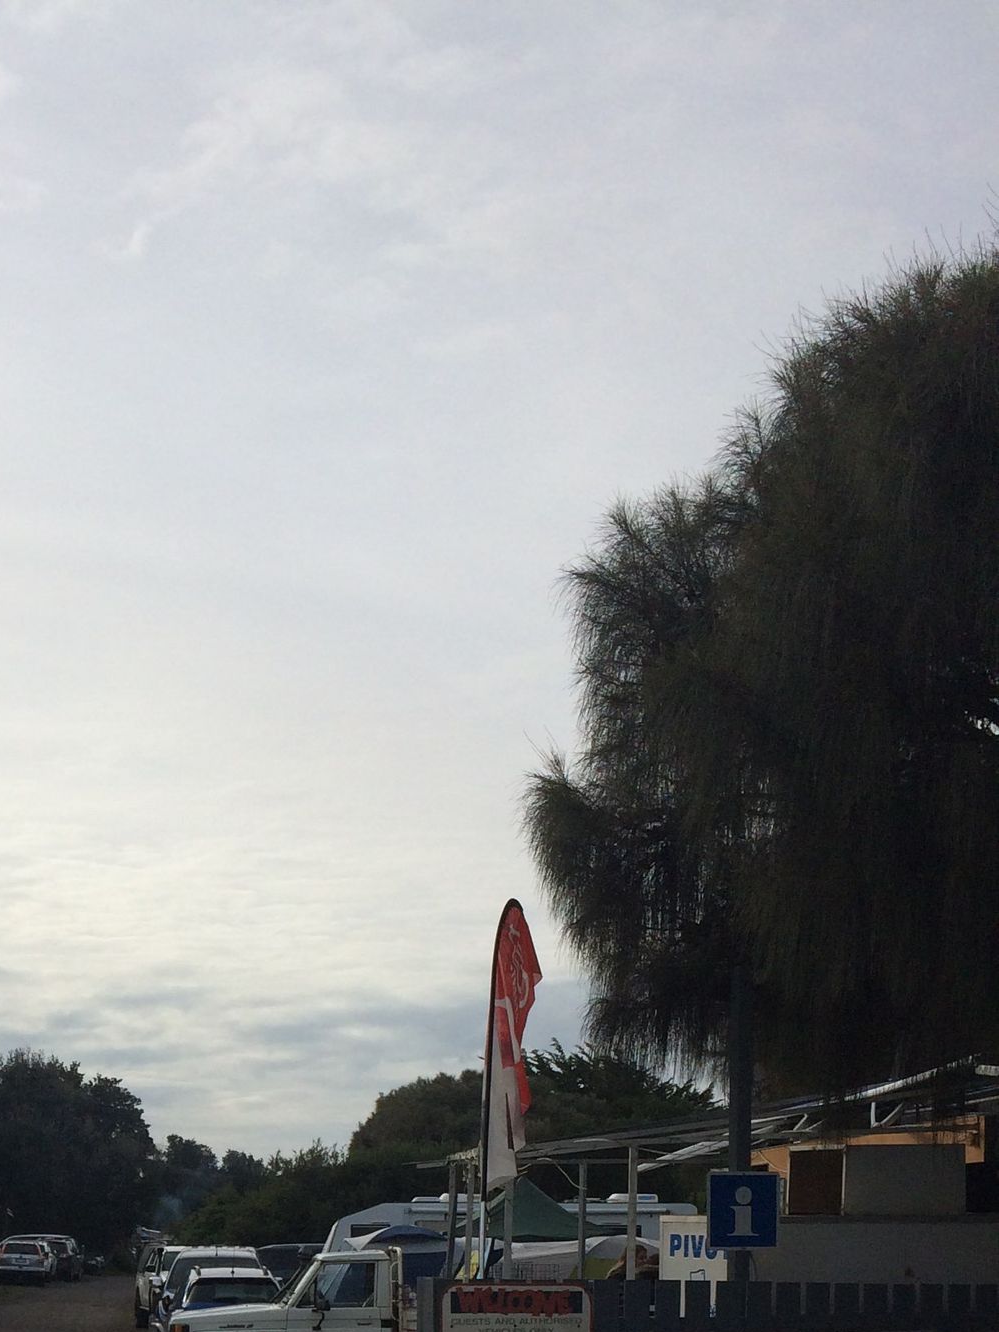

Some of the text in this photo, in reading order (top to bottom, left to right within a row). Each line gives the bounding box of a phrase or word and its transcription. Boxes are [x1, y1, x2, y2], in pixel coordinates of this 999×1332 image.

[456, 1287, 571, 1317] WELCOME
[451, 1317, 582, 1326] GUESTS AND AUTHORISED
